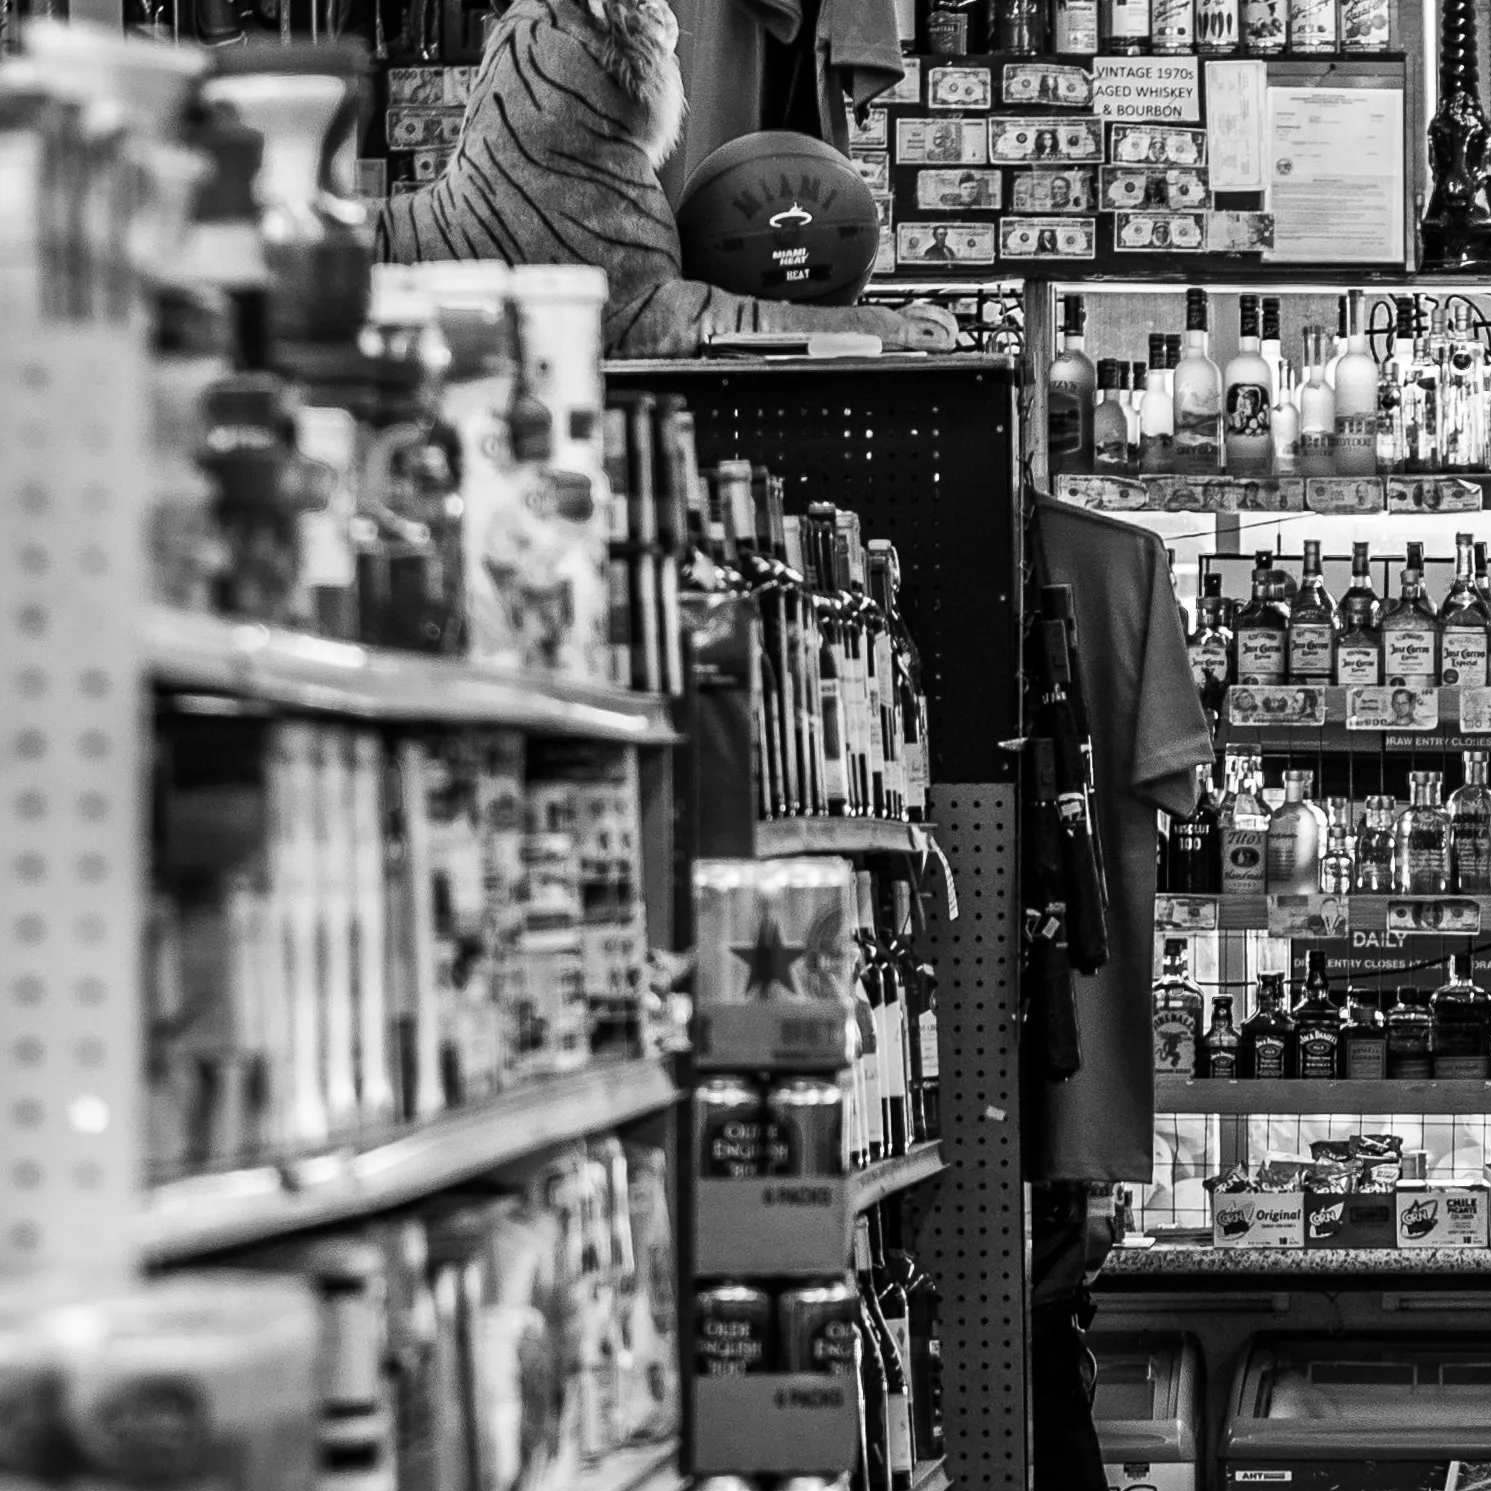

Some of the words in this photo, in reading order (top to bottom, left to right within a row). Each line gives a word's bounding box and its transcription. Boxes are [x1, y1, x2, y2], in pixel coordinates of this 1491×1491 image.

[1096, 66, 1152, 79] VINTAGE
[1157, 67, 1194, 80] 1970s
[1095, 85, 1132, 97] AGED
[1135, 86, 1193, 98] WHISKEY
[1102, 104, 1114, 115] &
[1116, 104, 1183, 117] BOURBON
[772, 247, 808, 260] MIAMI
[786, 268, 810, 282] HEAT
[1415, 737, 1448, 747] ENTRY
[1179, 837, 1202, 850] 100
[1353, 931, 1408, 948] DAILY
[1327, 959, 1362, 969] ENTRY
[1364, 959, 1406, 969] CLOSES
[1446, 1198, 1477, 1207] CHILE
[1216, 1208, 1245, 1226] CORN
[1256, 1208, 1301, 1223] Original
[1309, 1209, 1337, 1226] CORN
[1402, 1210, 1428, 1225] CORN
